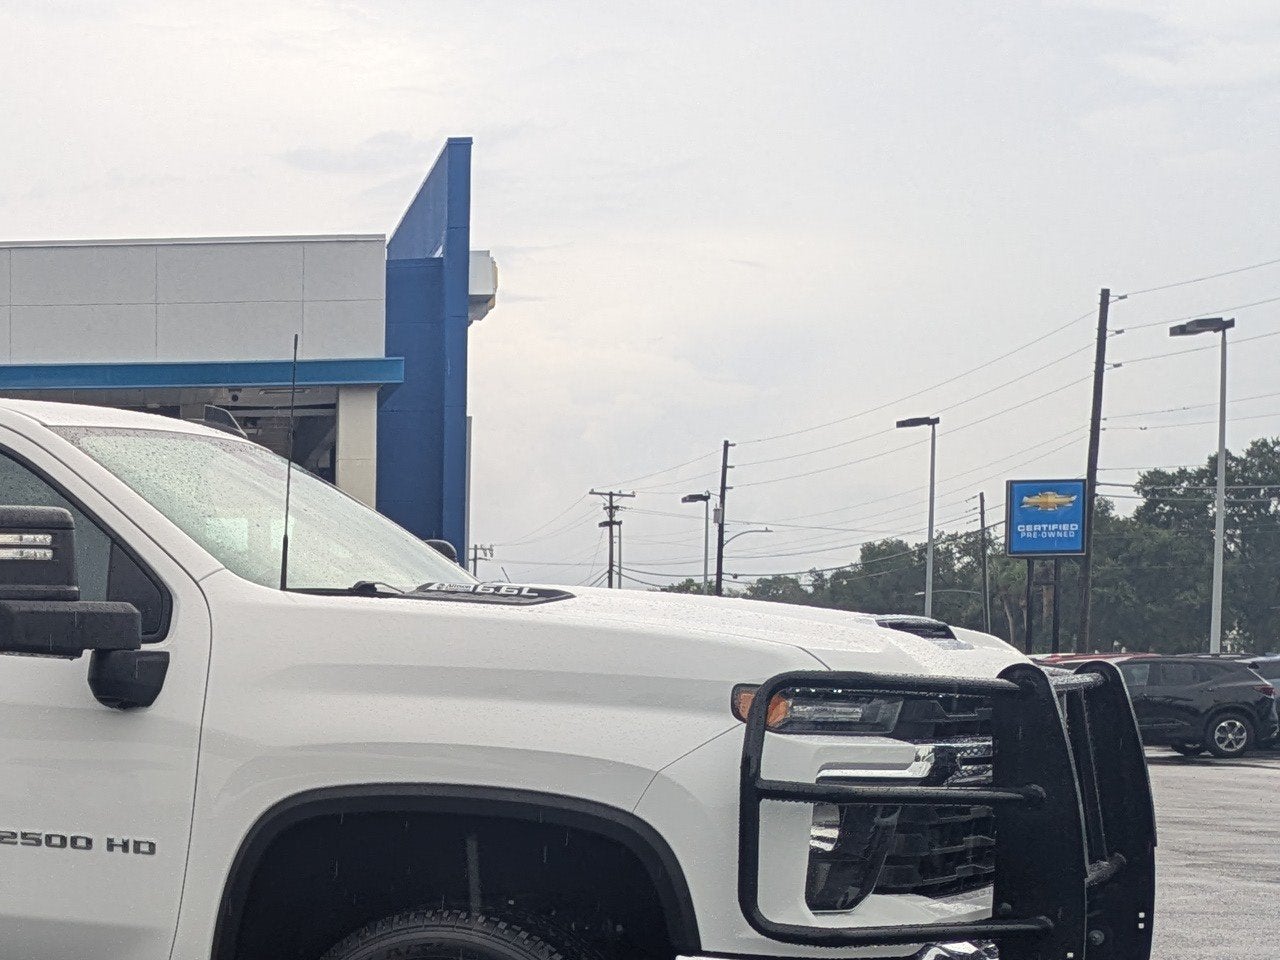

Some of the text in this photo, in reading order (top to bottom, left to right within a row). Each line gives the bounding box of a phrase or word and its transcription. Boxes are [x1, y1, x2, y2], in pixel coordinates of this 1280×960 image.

[1017, 523, 1079, 531] CERTIFIED
[475, 583, 539, 597] 6.6L
[106, 837, 156, 856] HD
